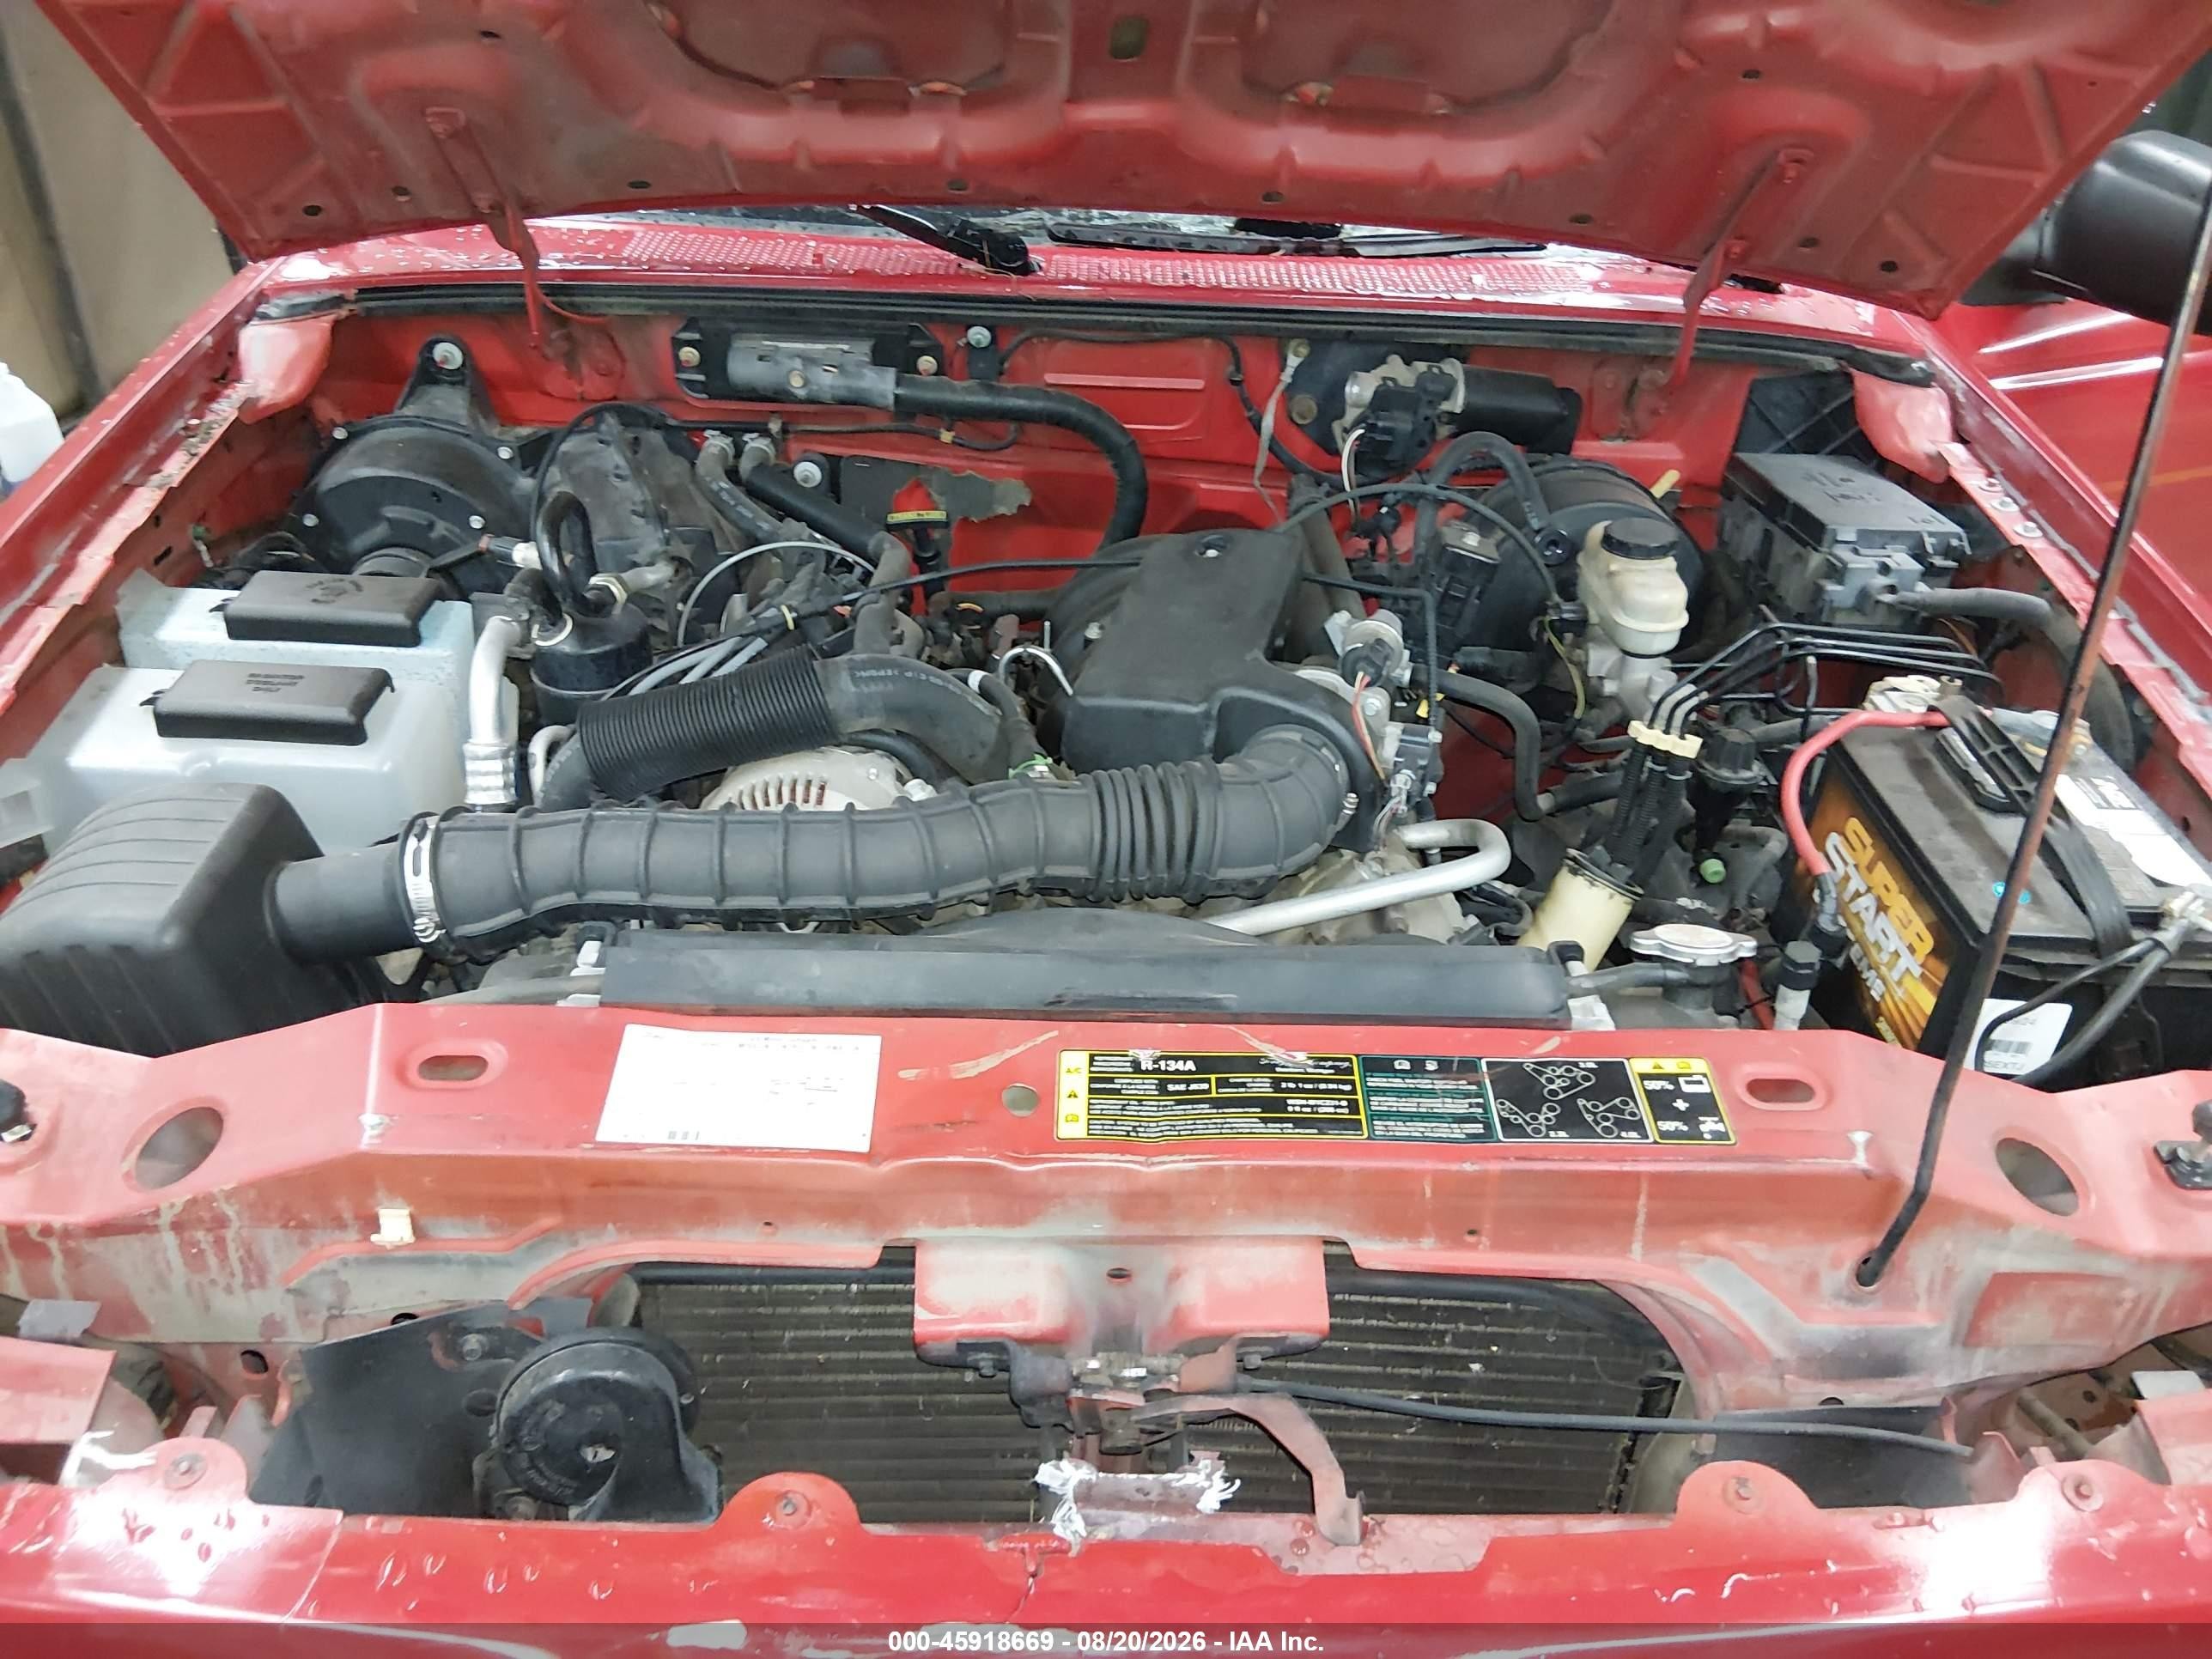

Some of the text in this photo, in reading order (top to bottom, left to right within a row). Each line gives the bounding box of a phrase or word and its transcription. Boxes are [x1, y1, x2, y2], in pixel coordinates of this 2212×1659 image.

[1839, 817, 1934, 964] SUPER
[1825, 831, 1923, 981] START
[1140, 1060, 1196, 1071] R-134A
[1643, 1079, 1675, 1091] 50%
[1656, 1121, 1689, 1131] 50%
